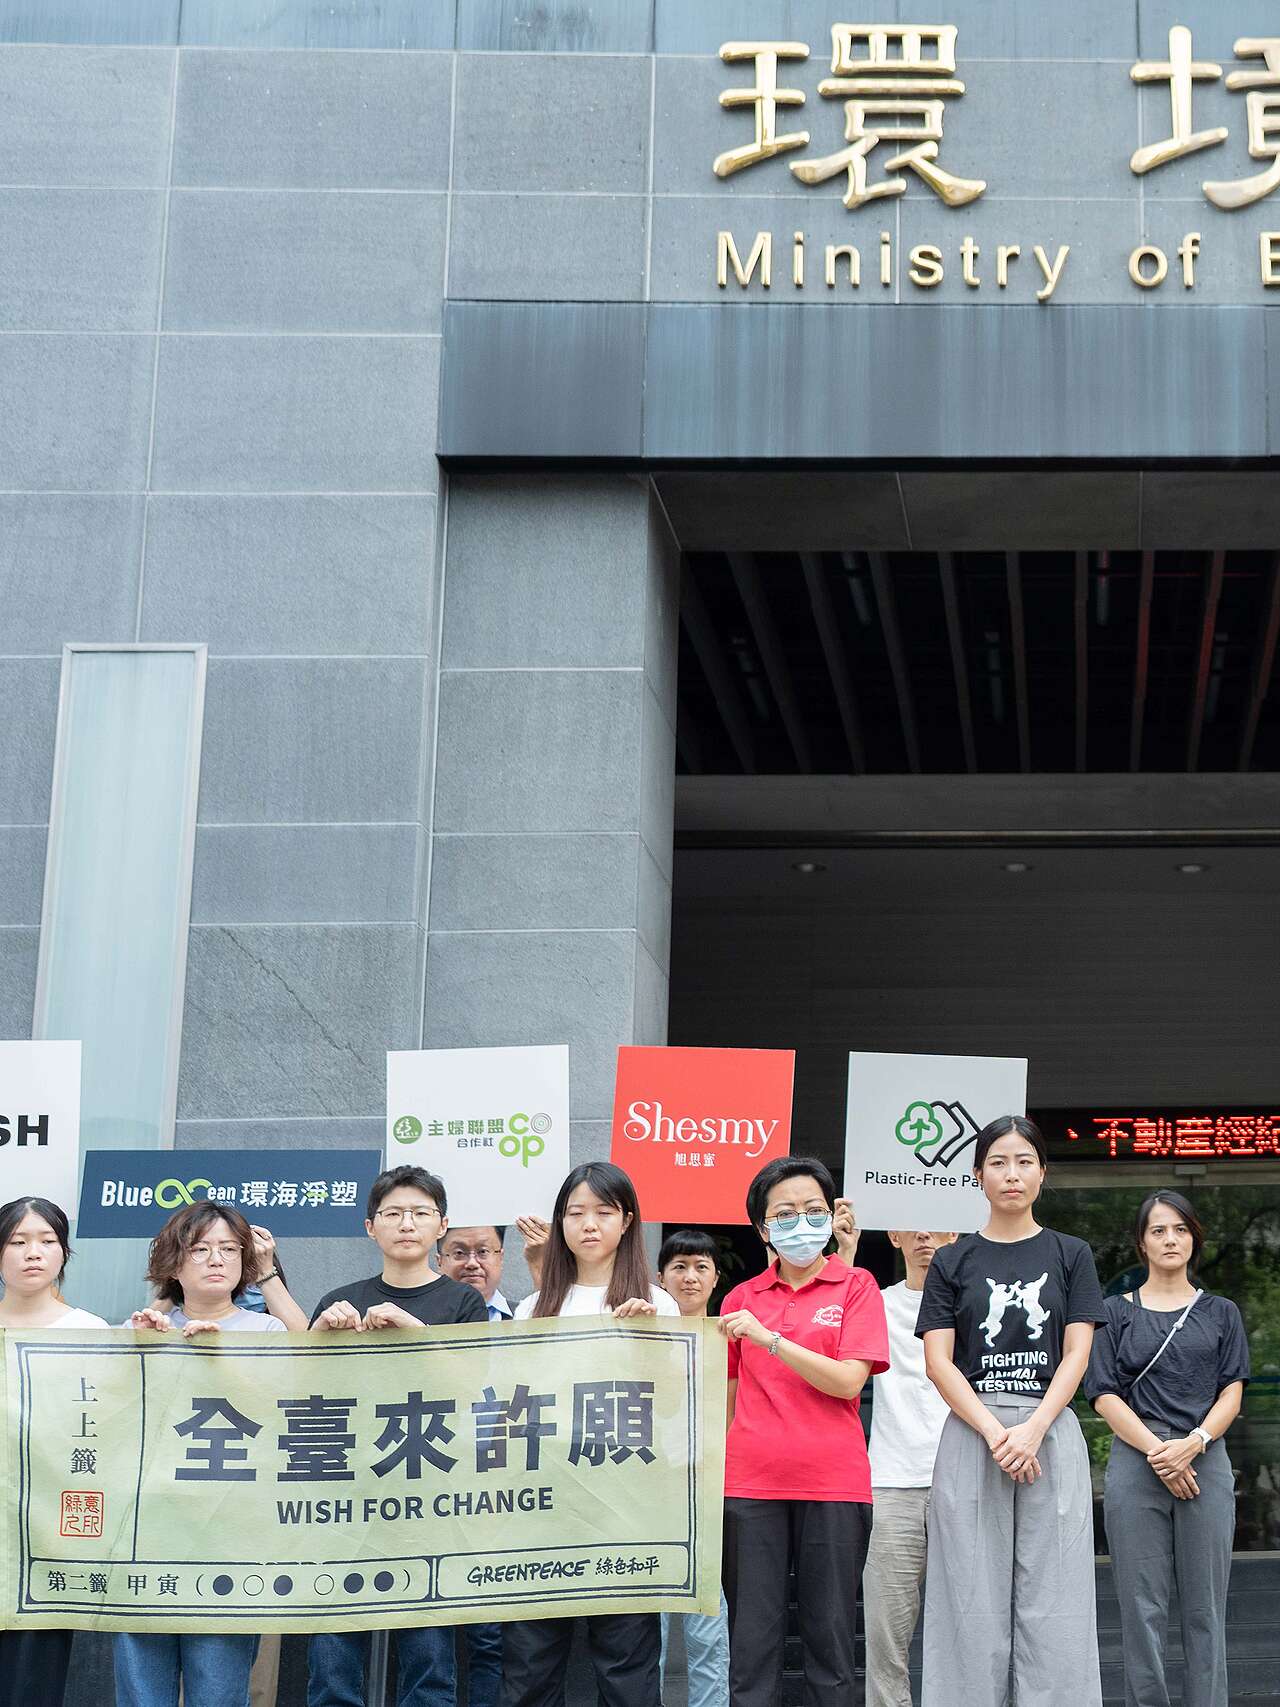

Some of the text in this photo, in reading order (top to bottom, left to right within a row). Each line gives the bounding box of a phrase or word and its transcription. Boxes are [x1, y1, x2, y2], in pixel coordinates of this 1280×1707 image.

[716, 231, 1070, 301] Ministry
[1129, 231, 1202, 287] of
[428, 1118, 505, 1136] 主婦聯盟
[623, 1101, 779, 1157] Shesmy
[456, 1137, 494, 1148] 合作社
[865, 1171, 957, 1186] Plastic-Free
[240, 1181, 358, 1208] 環海淨塑
[981, 1350, 1049, 1369] FIGHTING
[975, 1379, 1042, 1392] TESTING
[173, 1380, 657, 1482] 全臺來許願
[276, 1487, 554, 1525] WISH FOR CHANGE
[467, 1556, 660, 1587] GREENPEACE 綠色和平
